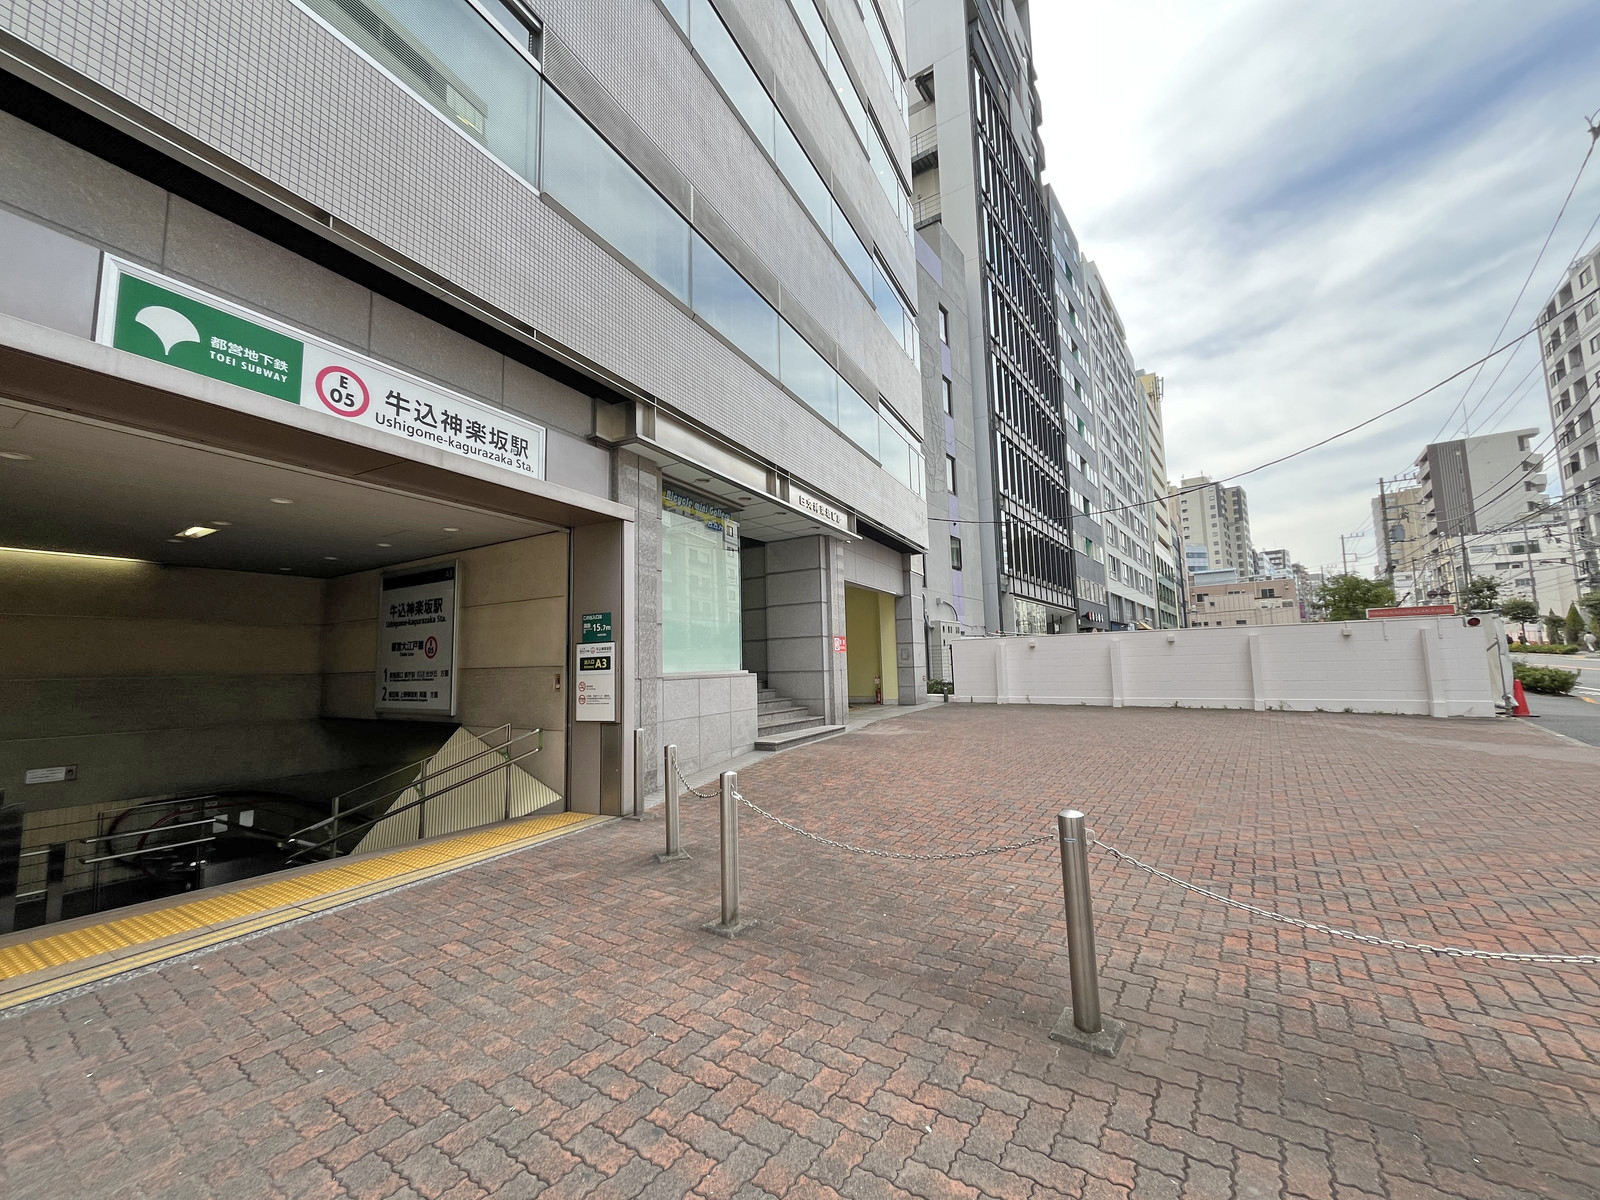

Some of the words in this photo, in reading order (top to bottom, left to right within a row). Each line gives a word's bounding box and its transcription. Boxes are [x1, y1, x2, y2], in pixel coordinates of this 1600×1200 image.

[210, 336, 289, 373] 都営地下鉄
[209, 350, 236, 367] TOEI
[241, 361, 288, 383] SUBWAY
[339, 375, 349, 390] E
[329, 388, 356, 408] 05
[384, 389, 530, 460] 牛込神楽坂駅
[375, 412, 513, 466] Ushigome-kagurazaka
[515, 459, 534, 473] Sta.
[666, 490, 693, 508] Bicycle
[592, 623, 612, 632] 15.7m
[595, 659, 607, 669] A3
